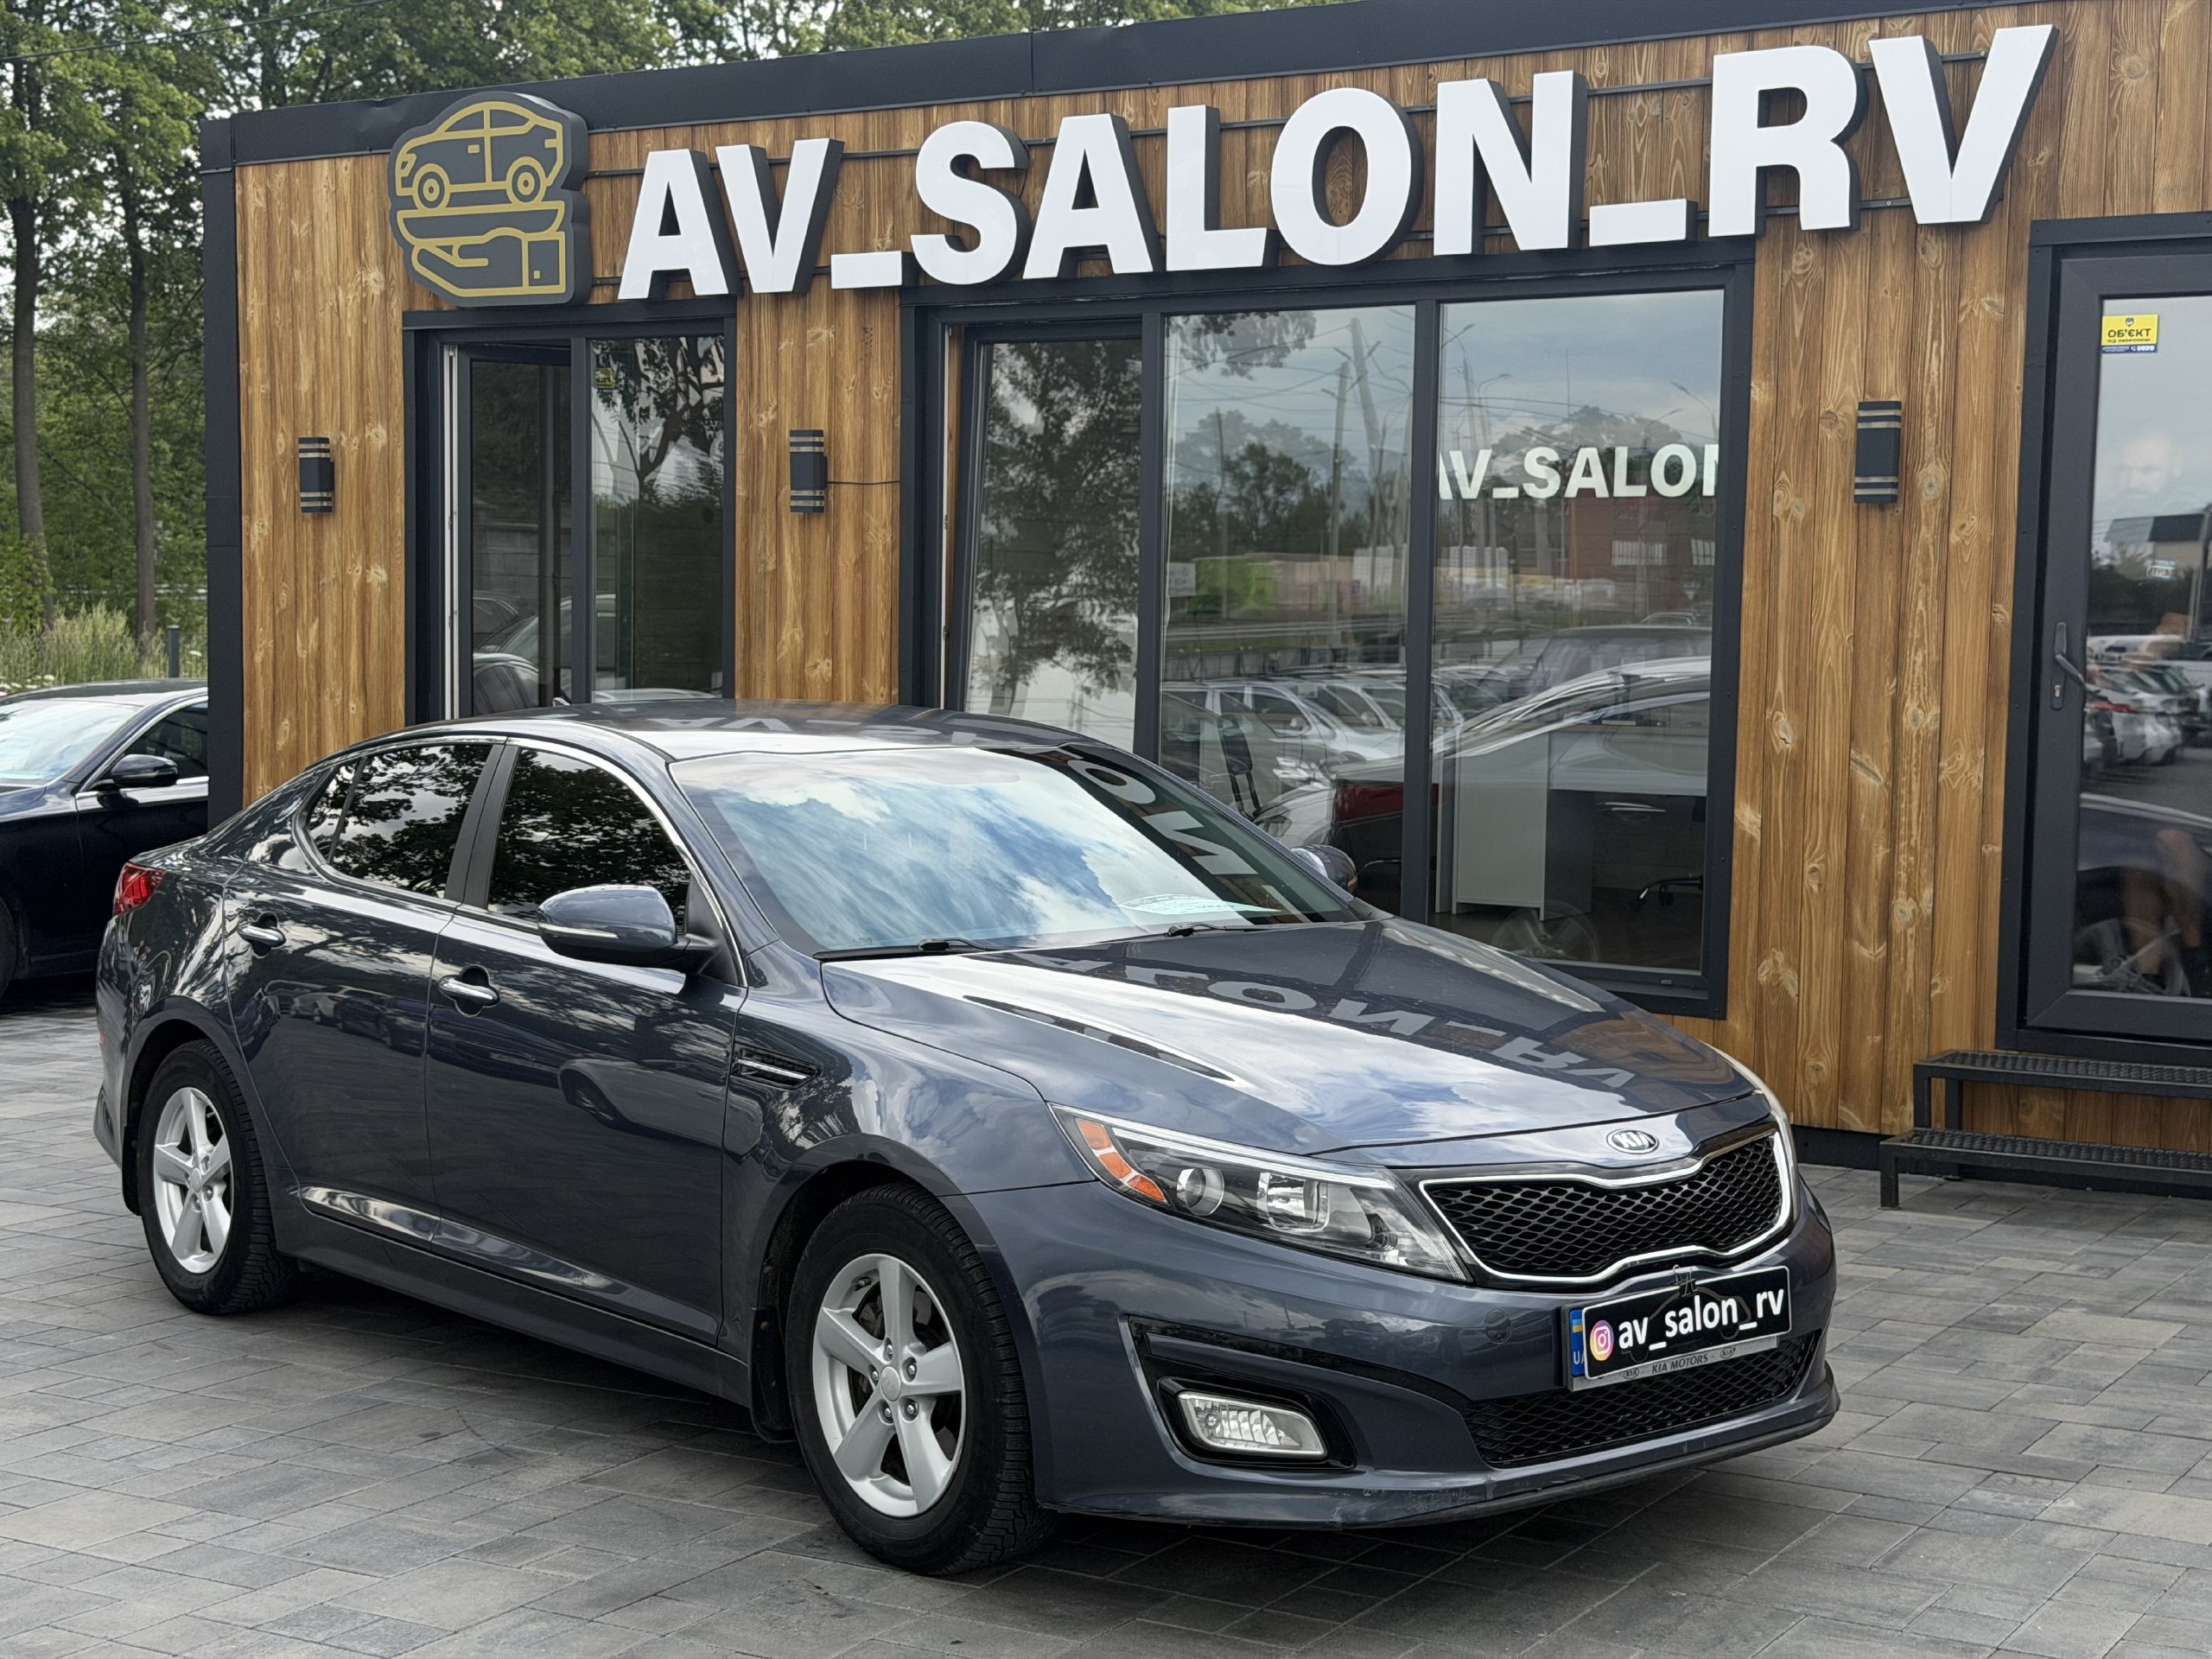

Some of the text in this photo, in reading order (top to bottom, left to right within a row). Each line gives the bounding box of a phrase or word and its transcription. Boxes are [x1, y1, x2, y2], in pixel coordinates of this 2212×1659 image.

[618, 24, 2056, 300] AV_SALON_RV
[1618, 1289, 1784, 1351] av_salon_rv
[1651, 1363, 1668, 1374] KIA
[1670, 1353, 1708, 1370] MOTORS
